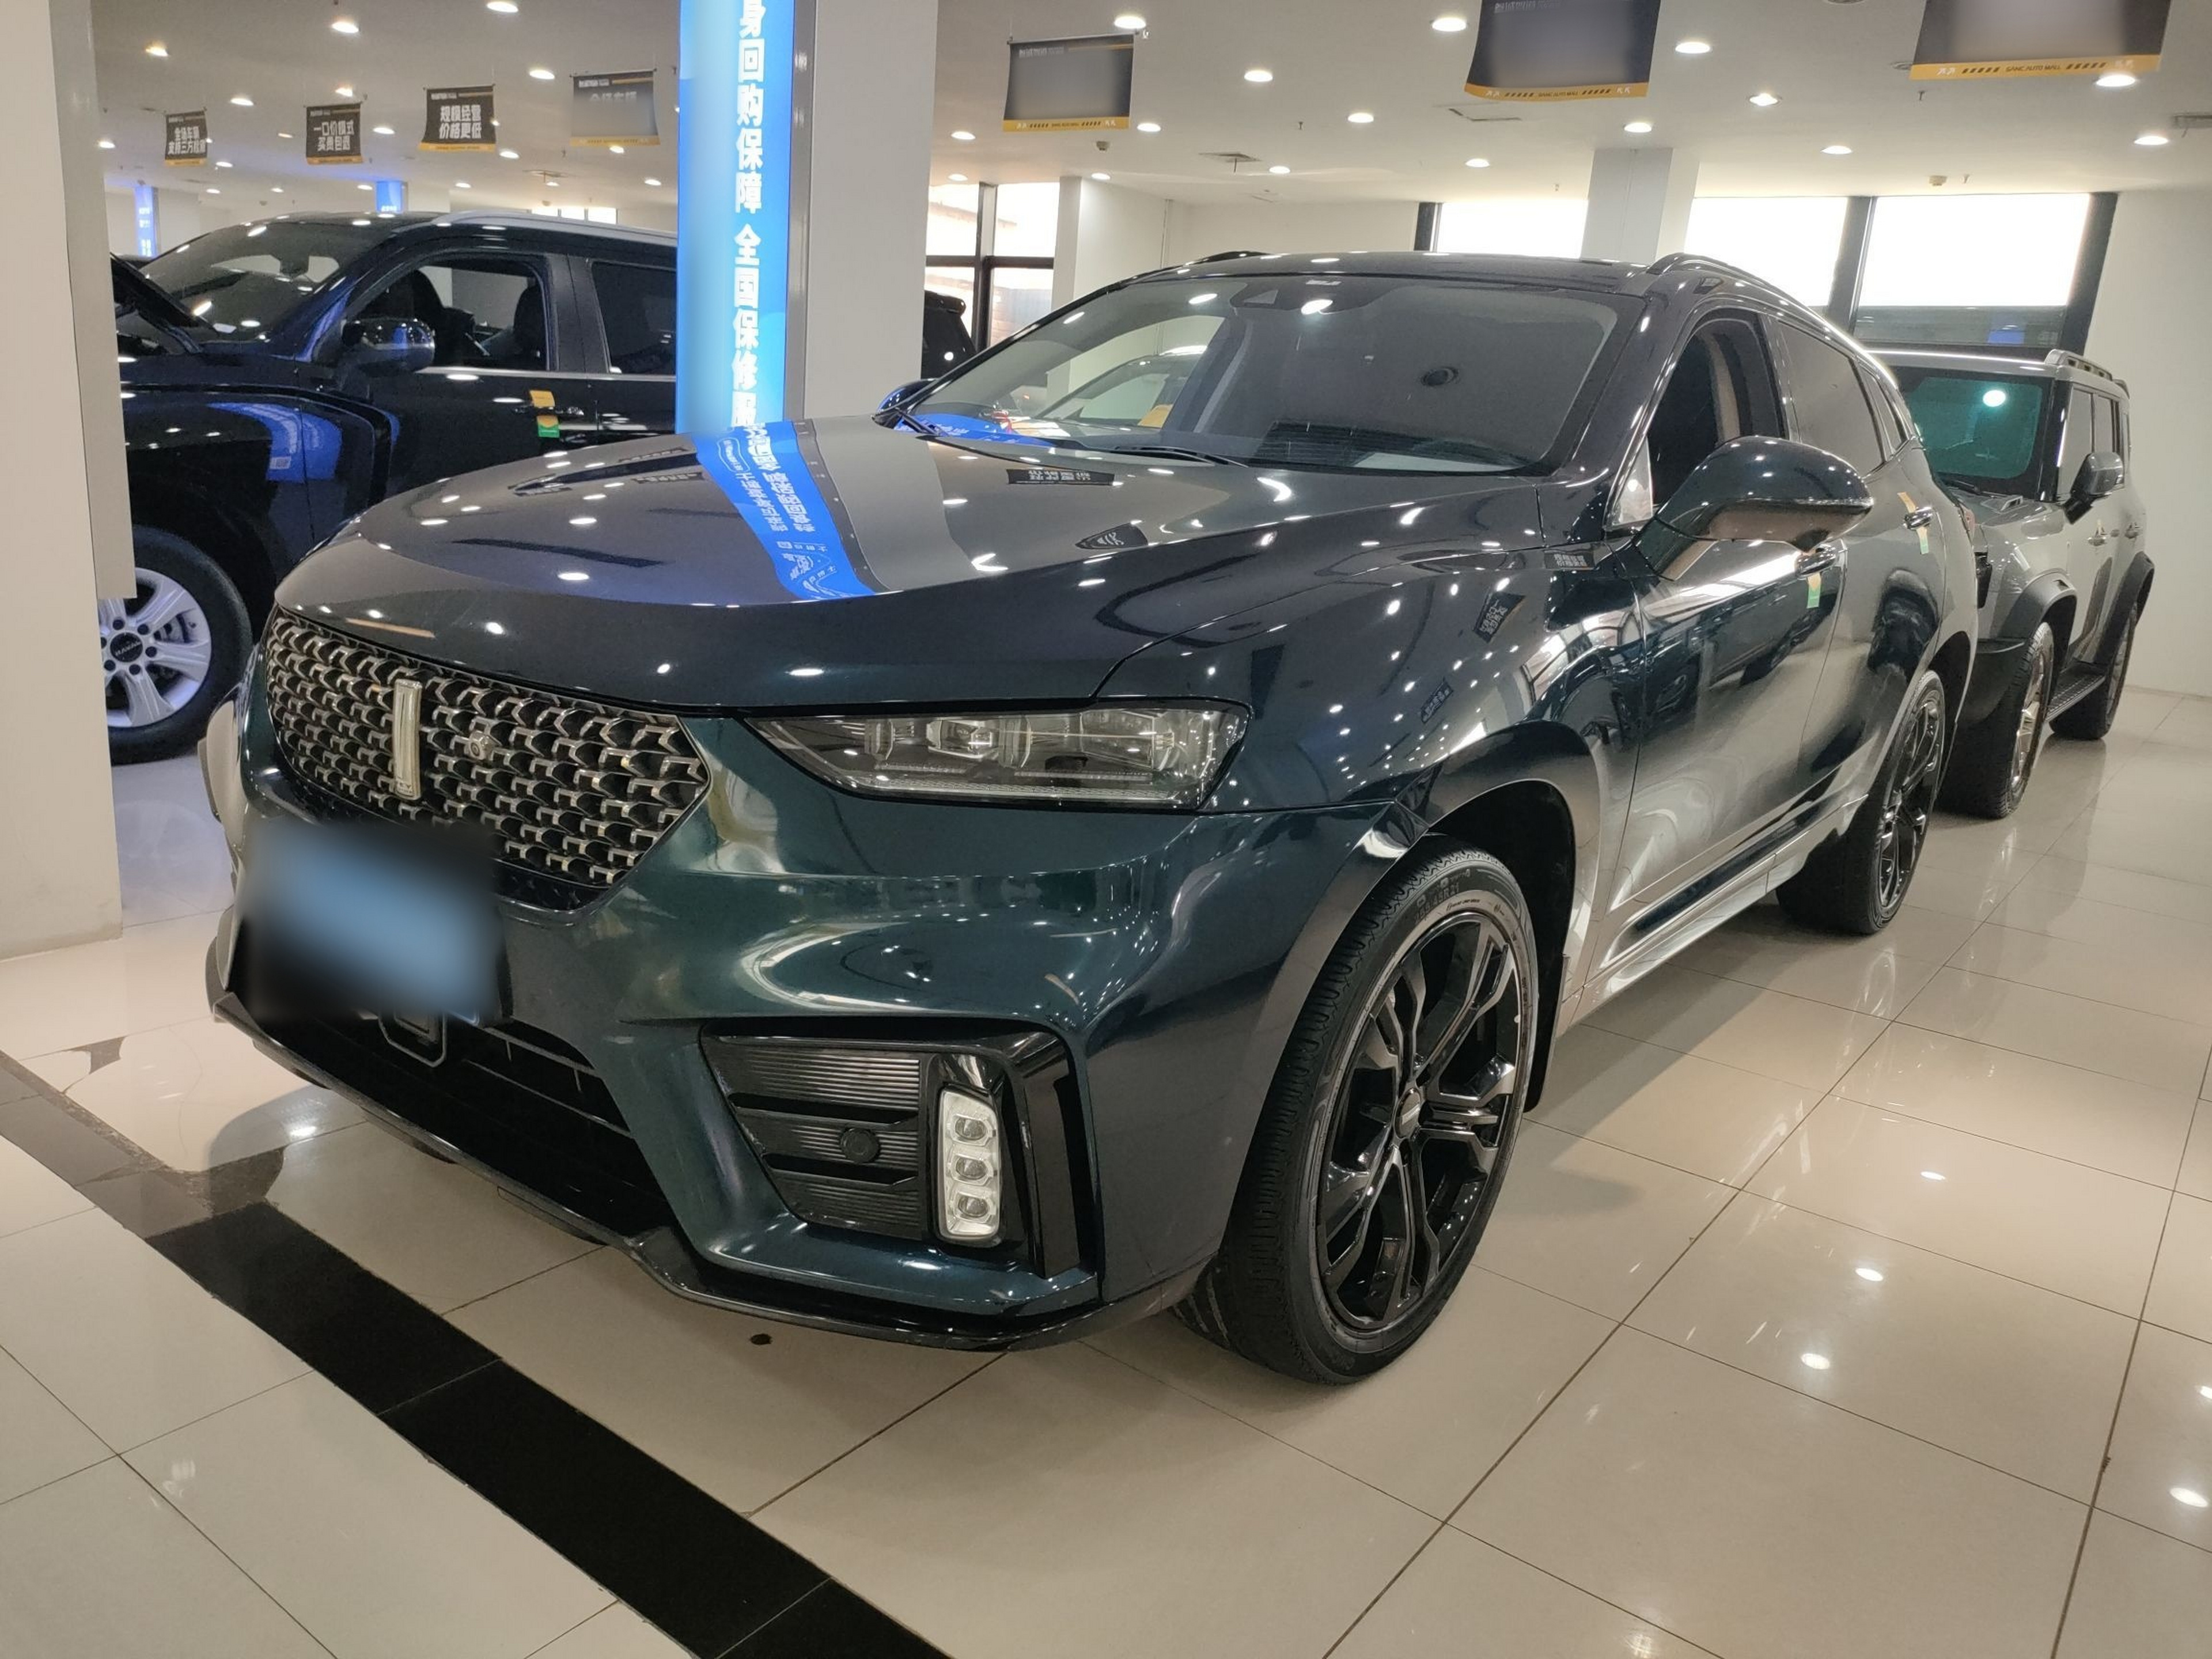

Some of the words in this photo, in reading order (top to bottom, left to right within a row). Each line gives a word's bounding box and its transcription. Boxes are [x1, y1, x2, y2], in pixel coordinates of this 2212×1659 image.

[440, 104, 482, 122] 规模经营
[313, 119, 355, 137] 一口价模式
[439, 122, 482, 139] 价格更低
